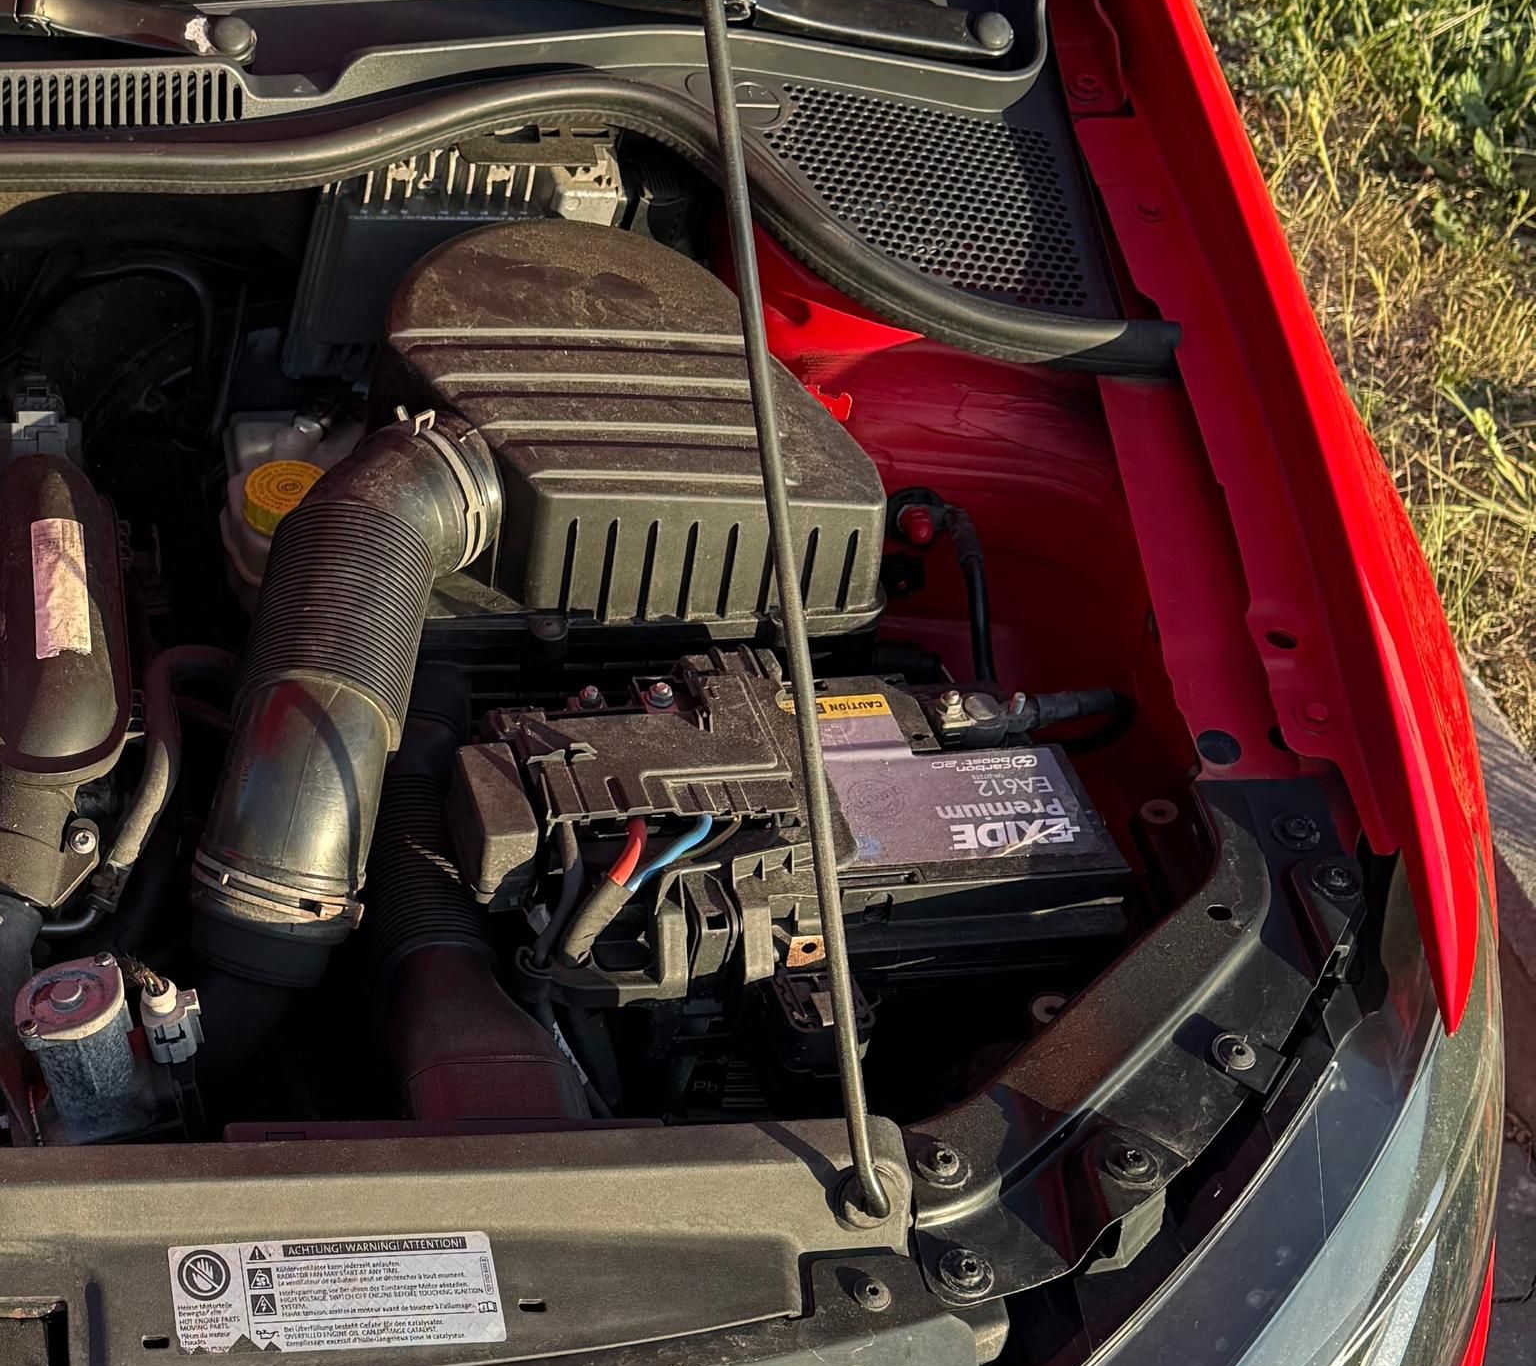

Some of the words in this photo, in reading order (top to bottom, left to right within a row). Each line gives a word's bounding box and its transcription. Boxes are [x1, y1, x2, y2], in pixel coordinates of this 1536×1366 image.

[829, 700, 883, 711] CAUTION
[974, 776, 1053, 797] EA612
[936, 798, 1065, 822] Premium
[951, 817, 1079, 850] EXIDE
[692, 1080, 718, 1093] Pb
[287, 1242, 342, 1256] ACHTUNG!
[345, 1240, 400, 1253] WARNING!
[402, 1237, 463, 1250] ATTENTION!
